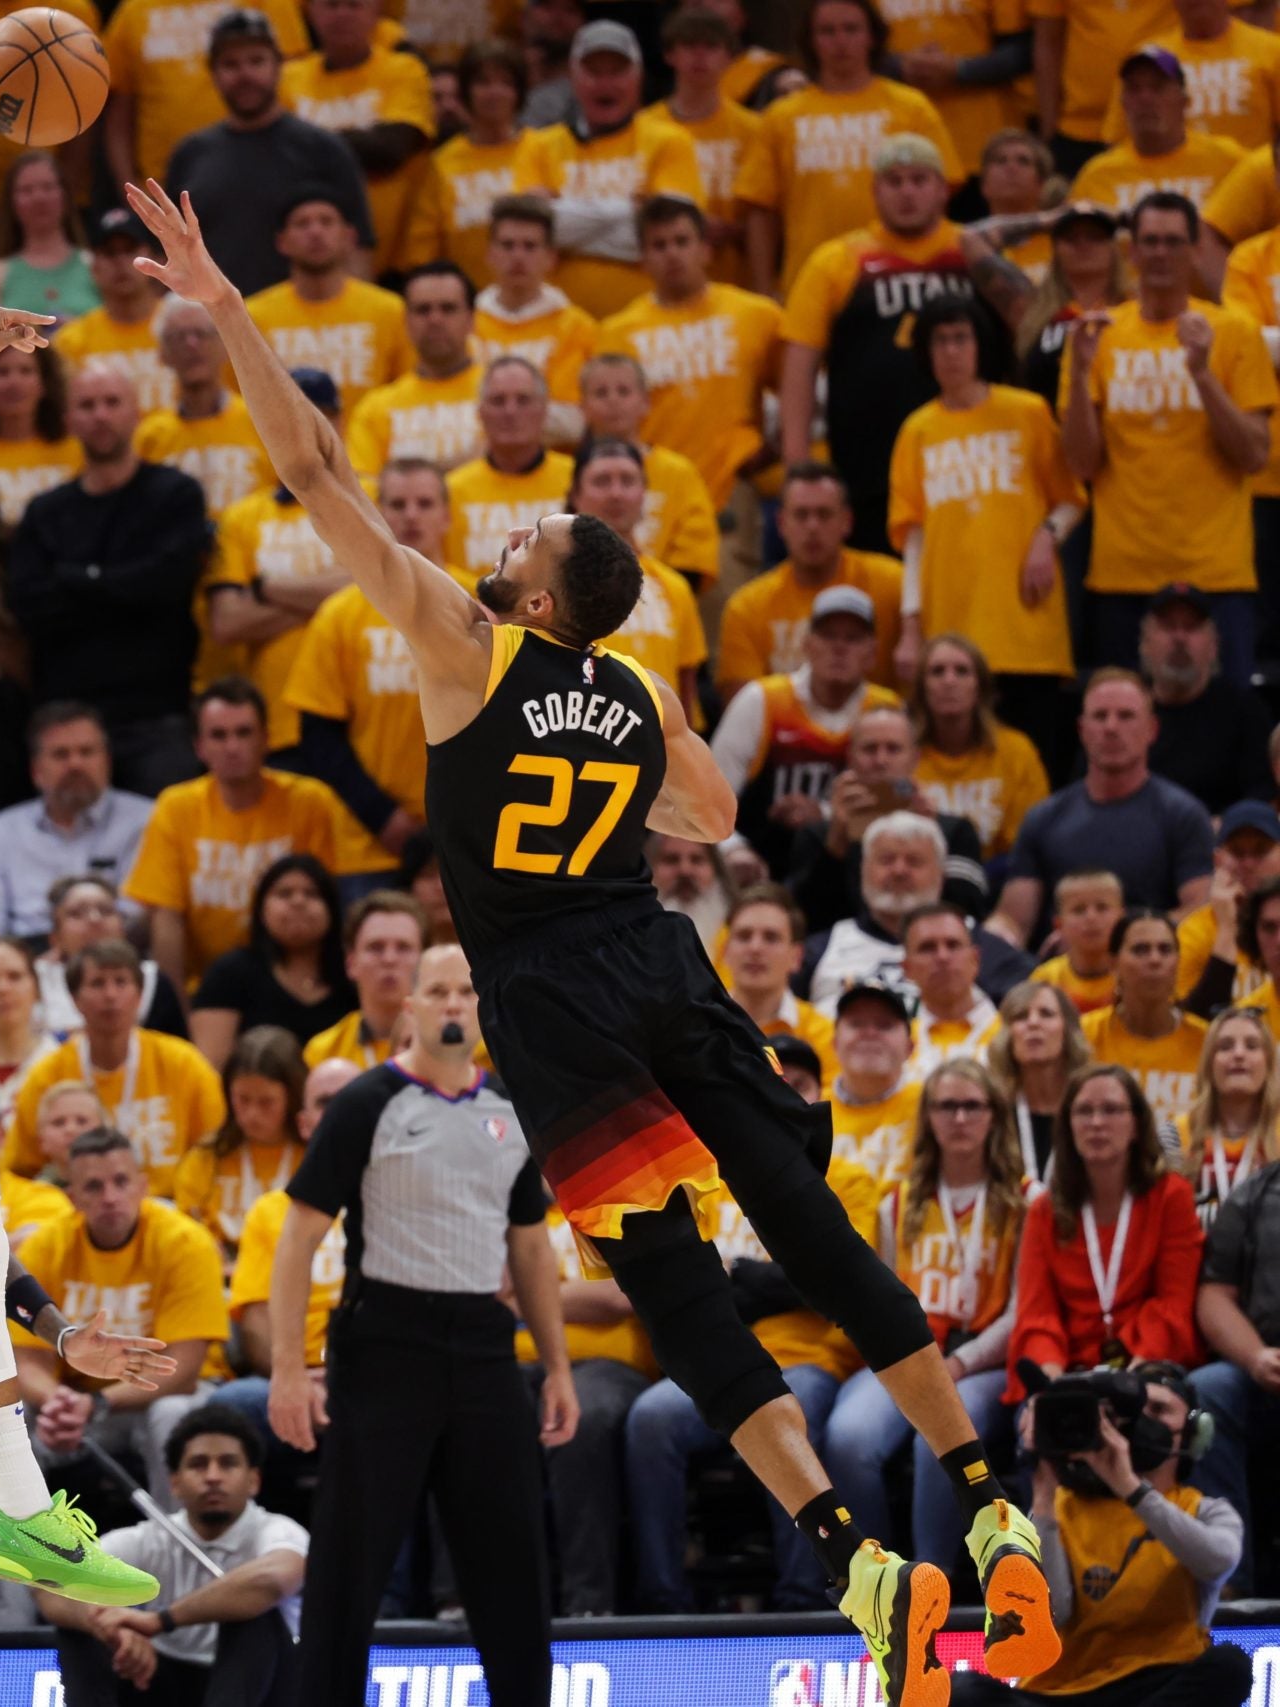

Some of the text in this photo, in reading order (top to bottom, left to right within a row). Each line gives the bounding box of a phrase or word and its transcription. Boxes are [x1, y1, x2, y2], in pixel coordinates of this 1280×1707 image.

[1113, 346, 1191, 381] TAK
[921, 429, 1024, 474] TAKE
[522, 691, 643, 747] GOBERT
[493, 753, 641, 876] 27
